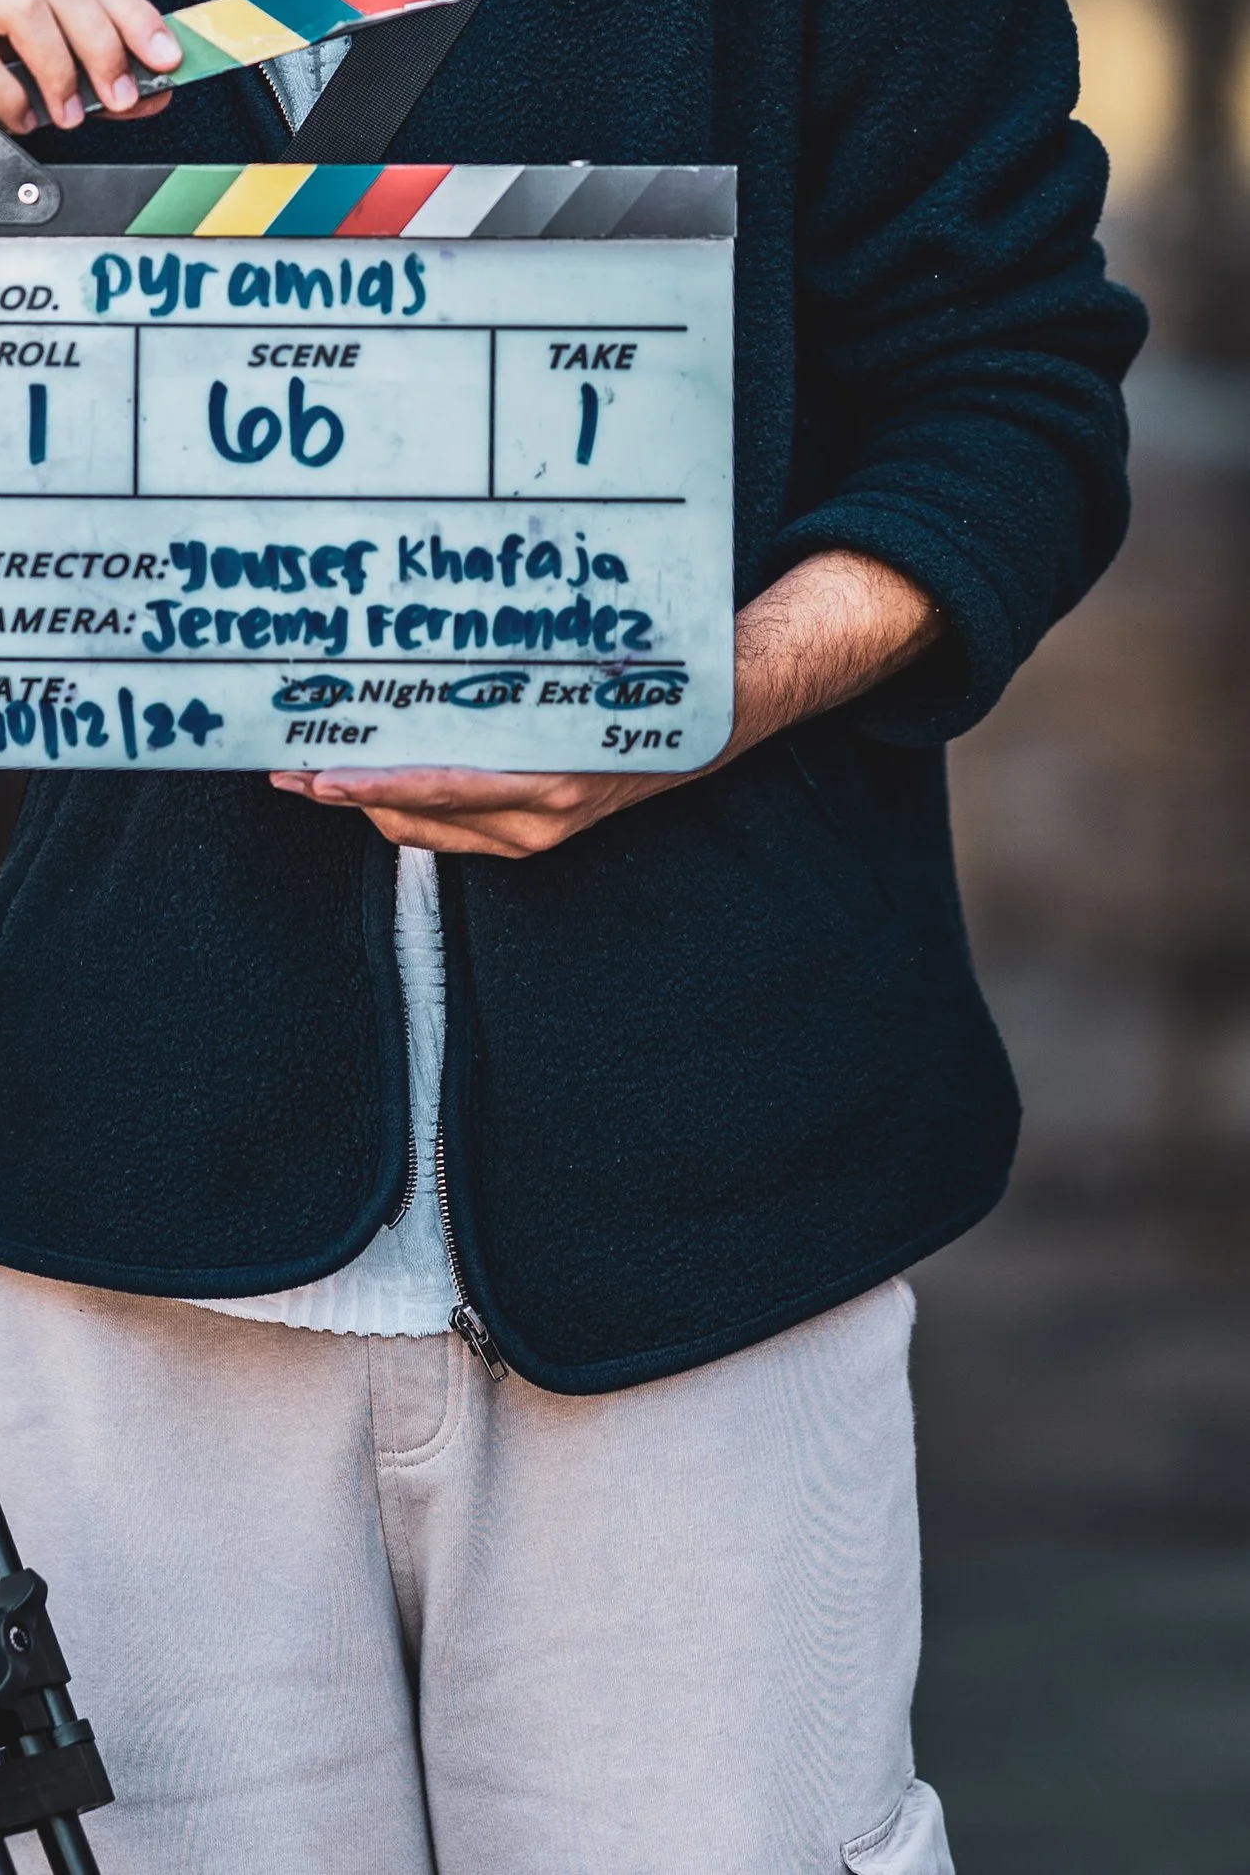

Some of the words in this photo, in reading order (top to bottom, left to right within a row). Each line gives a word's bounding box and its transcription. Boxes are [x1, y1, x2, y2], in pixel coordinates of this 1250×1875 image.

[247, 343, 361, 368] SCENE
[549, 342, 638, 371] TAKE
[141, 599, 348, 656] Jeremy
[366, 592, 653, 653] Fernandez
[539, 681, 591, 705] Ext
[614, 682, 683, 705] Mos
[285, 720, 379, 745] Filter
[601, 724, 684, 756] Sync
